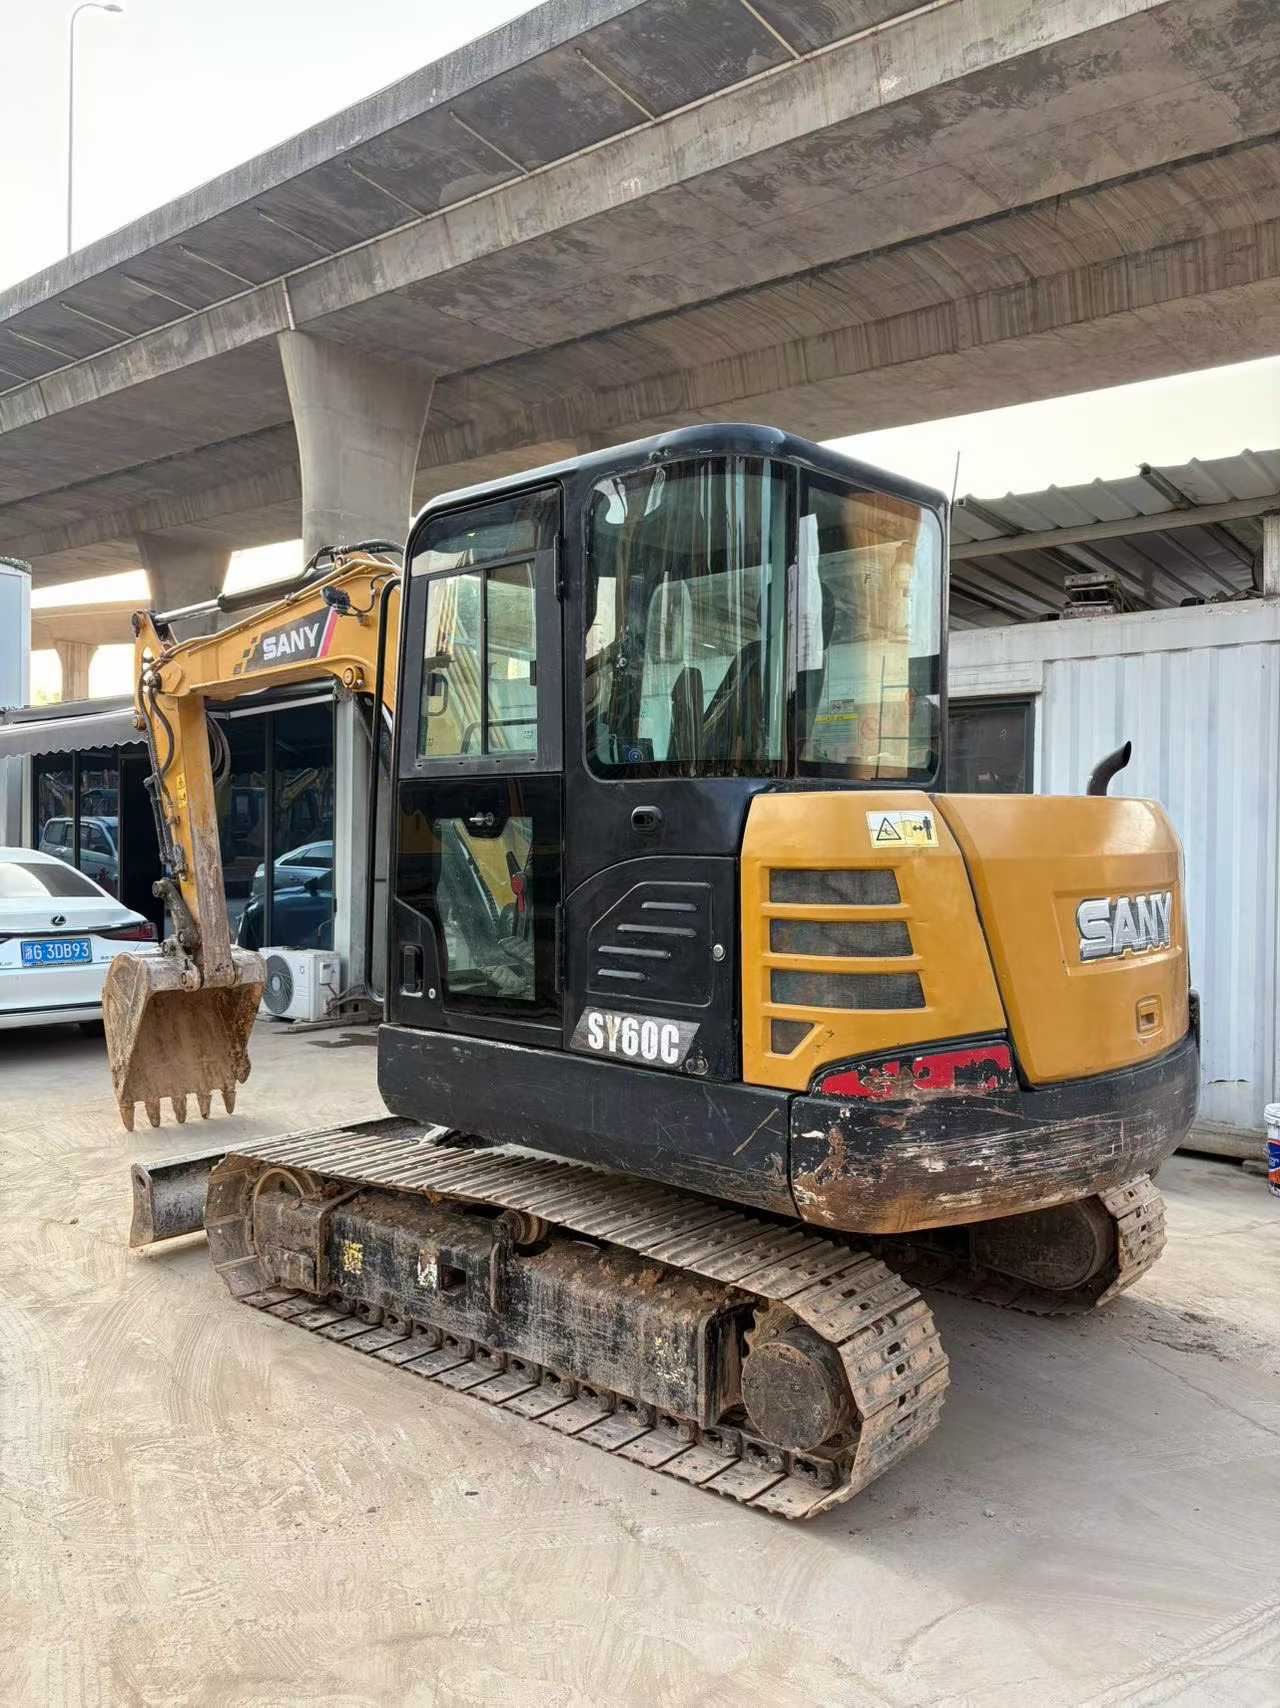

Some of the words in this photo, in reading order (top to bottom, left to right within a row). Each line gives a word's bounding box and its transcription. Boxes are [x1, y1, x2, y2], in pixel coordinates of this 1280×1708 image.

[263, 623, 319, 660] SANY
[1076, 891, 1172, 960] SANY
[587, 1012, 680, 1064] SY60C
